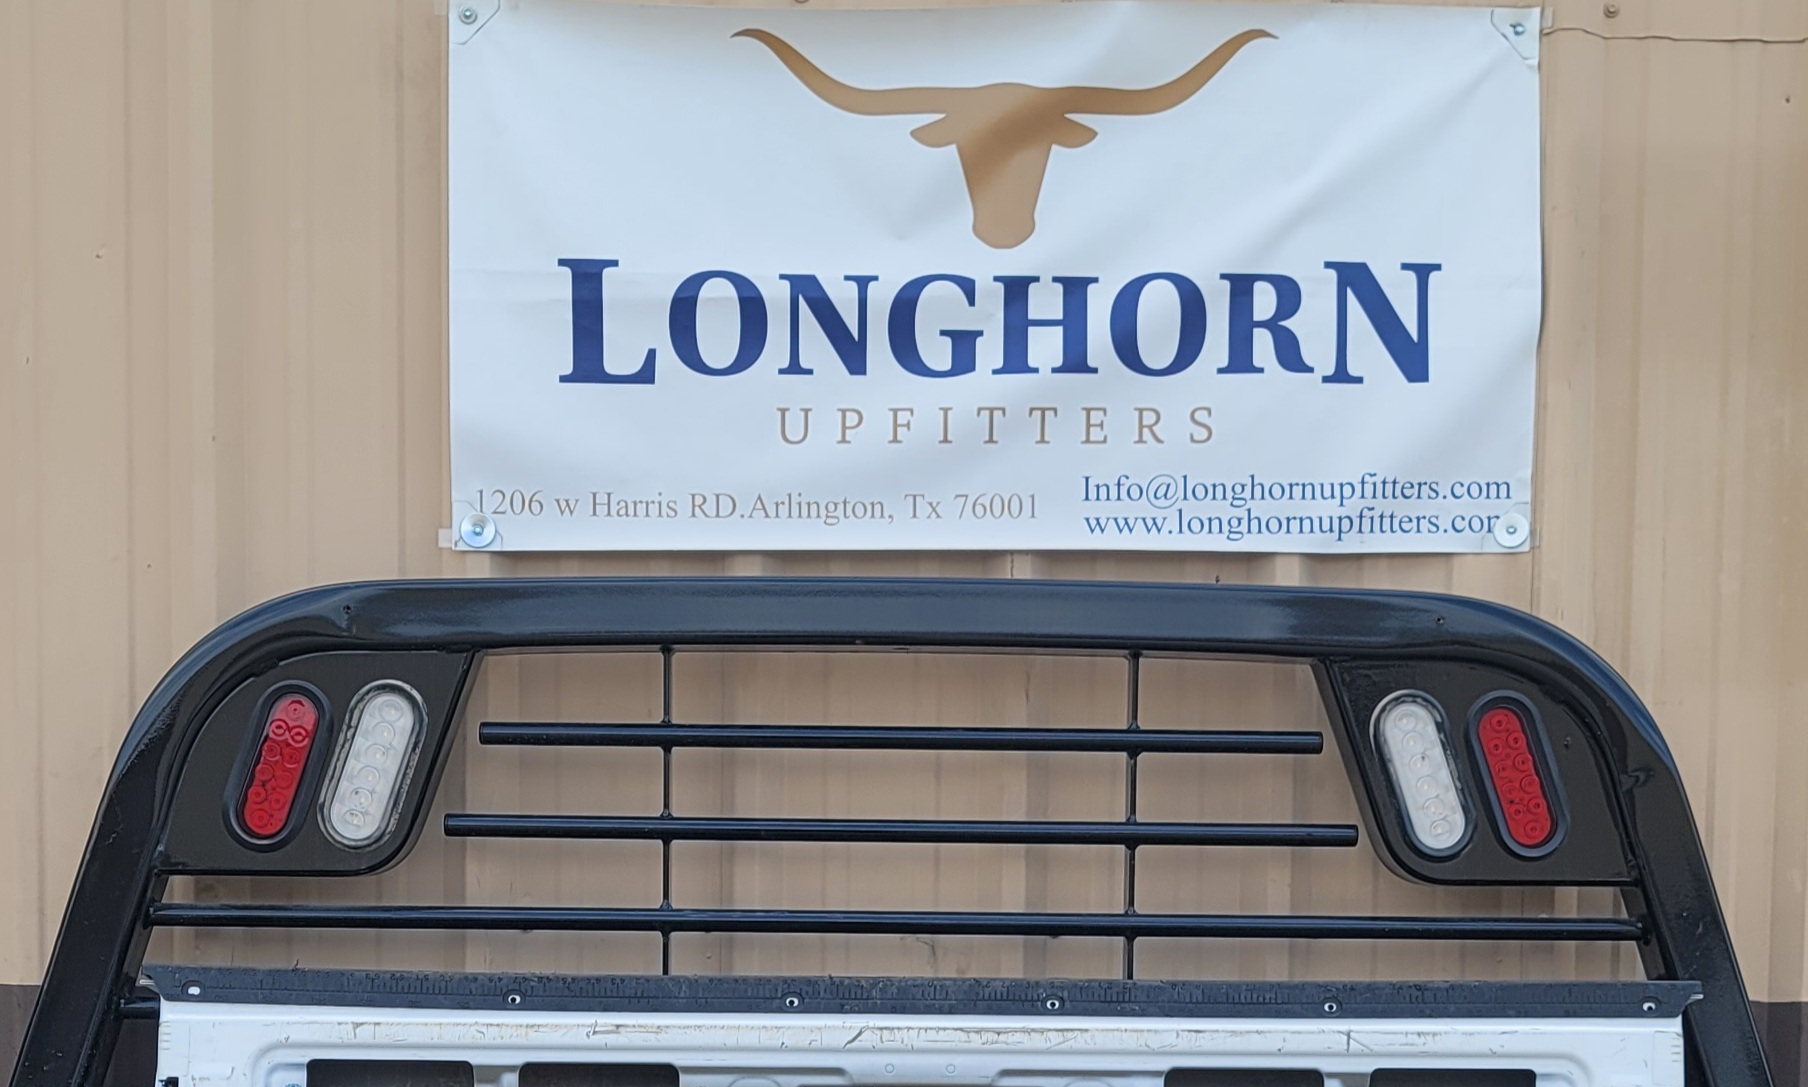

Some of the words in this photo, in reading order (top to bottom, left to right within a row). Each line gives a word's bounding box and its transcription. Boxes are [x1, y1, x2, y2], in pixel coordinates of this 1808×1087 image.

[557, 258, 1443, 386] LONGHORN
[776, 406, 1216, 446] UPFITTERS
[475, 488, 544, 517] 1206
[553, 497, 581, 518] w
[588, 490, 679, 520] Harris
[903, 491, 942, 521] Tx
[951, 491, 1040, 521] 76001
[1081, 473, 1512, 509] Info@longhornupfitters.com
